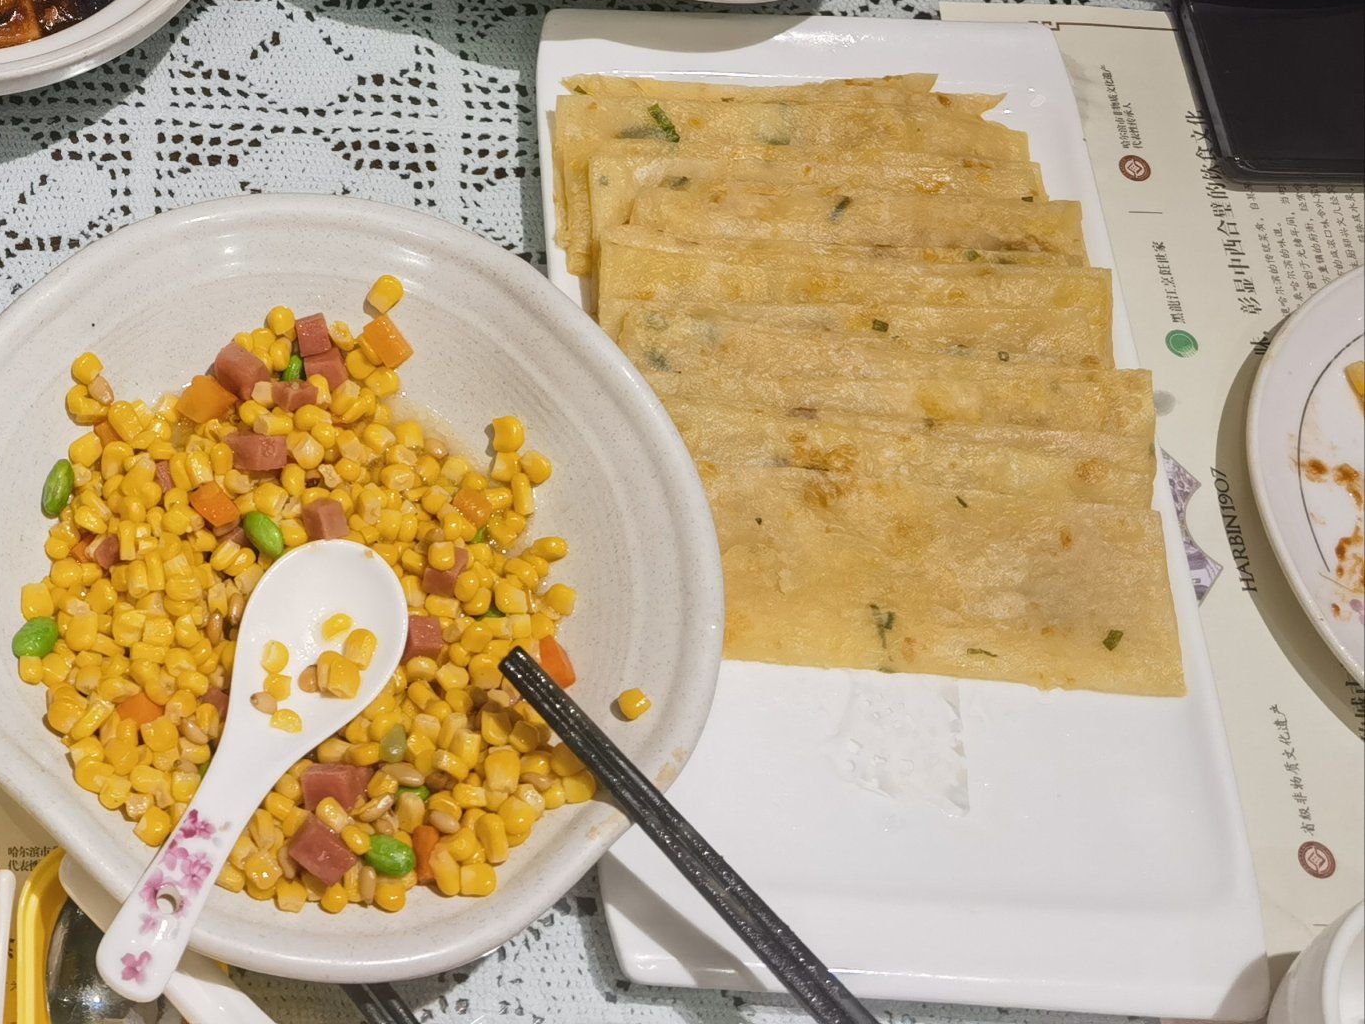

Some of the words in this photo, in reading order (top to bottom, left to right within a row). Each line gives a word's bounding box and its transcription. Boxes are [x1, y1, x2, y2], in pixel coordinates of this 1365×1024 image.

[1268, 703, 1315, 837] 省级非物质文化遗产
